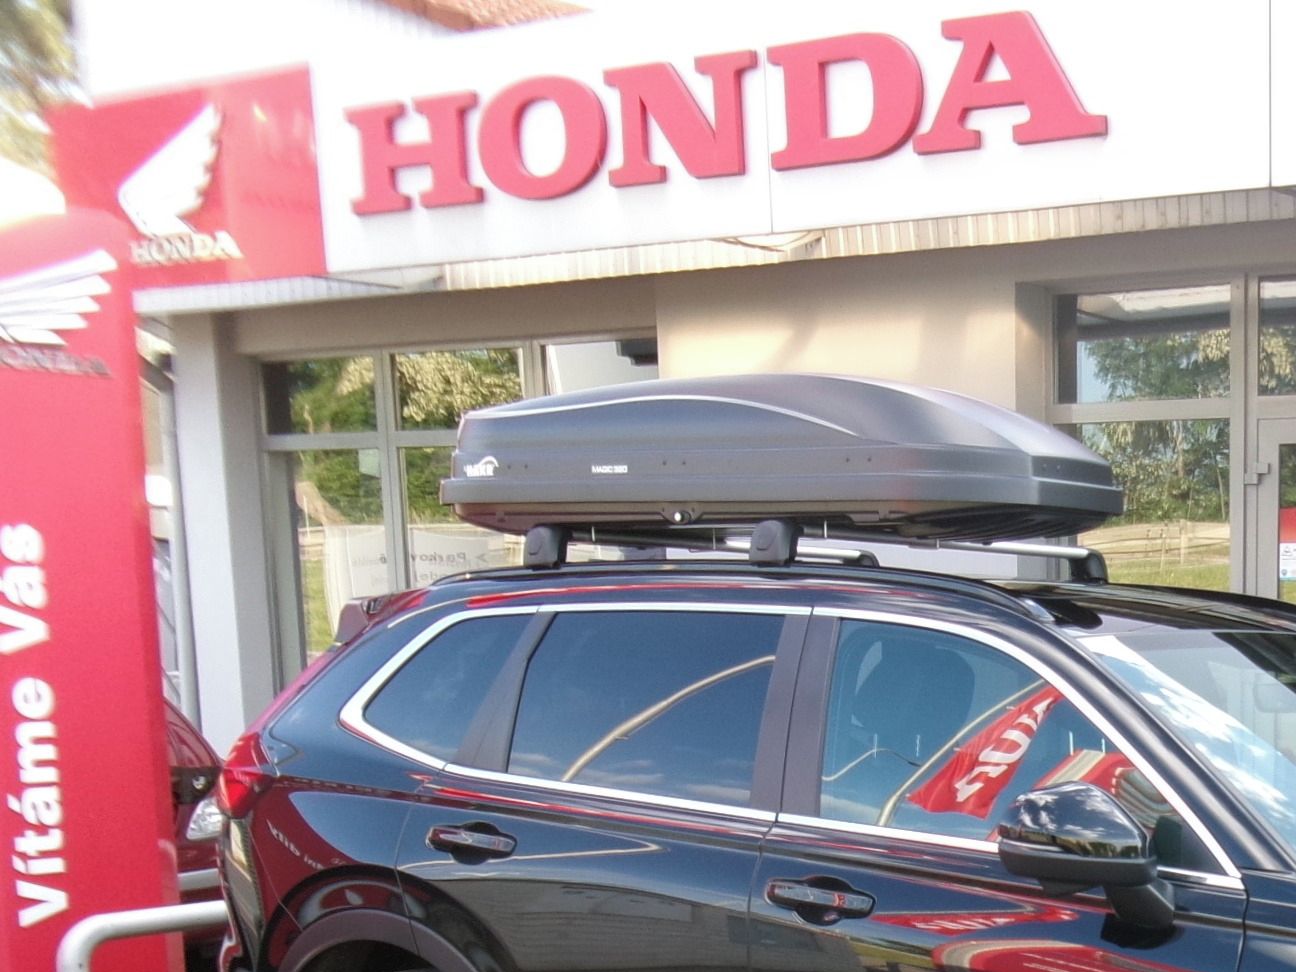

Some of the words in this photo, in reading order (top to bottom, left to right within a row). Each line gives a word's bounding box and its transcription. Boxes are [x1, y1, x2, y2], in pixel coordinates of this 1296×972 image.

[343, 9, 1108, 217] HONDA
[129, 230, 244, 266] HONDA
[7, 676, 70, 928] Vítáme
